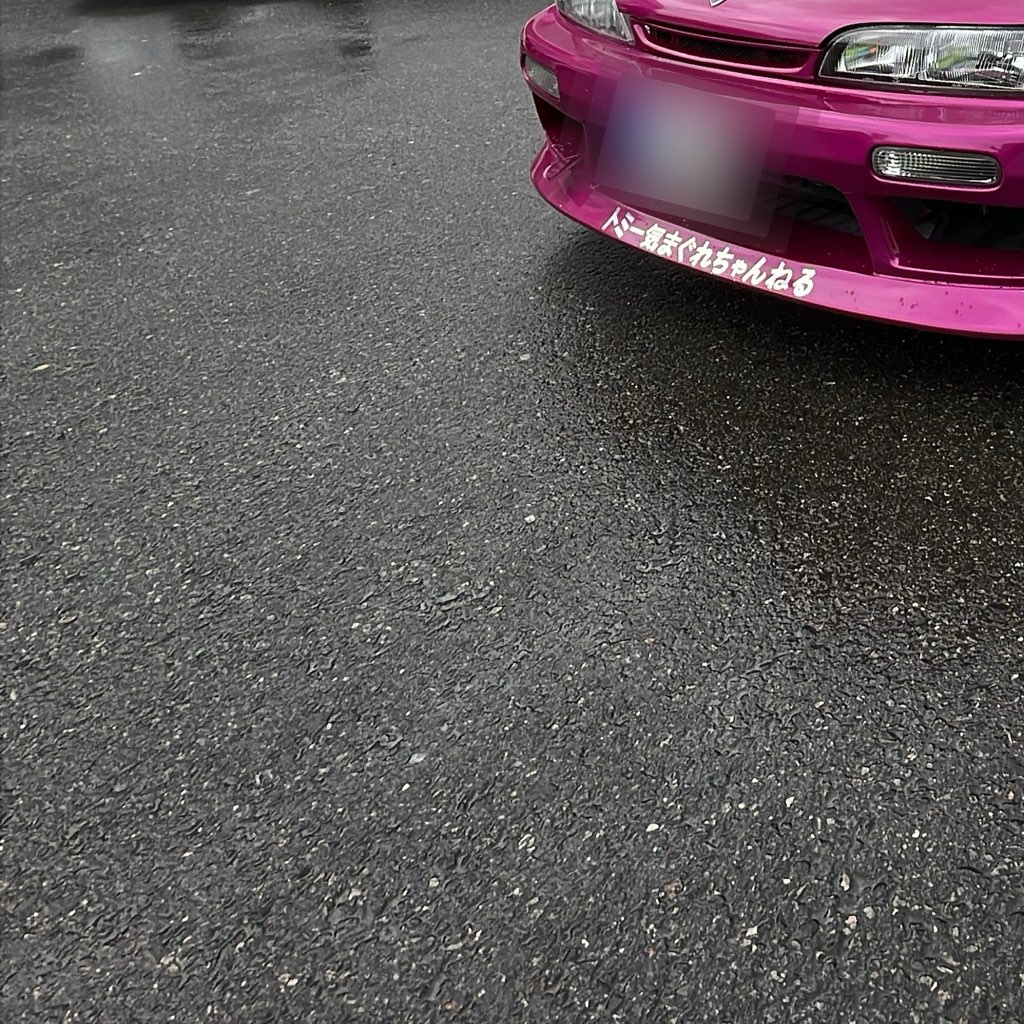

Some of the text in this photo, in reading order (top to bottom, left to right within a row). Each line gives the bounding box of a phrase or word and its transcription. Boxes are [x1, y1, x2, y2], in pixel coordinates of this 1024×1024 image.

[601, 206, 816, 297] トミー気まぐれちゃんねる
